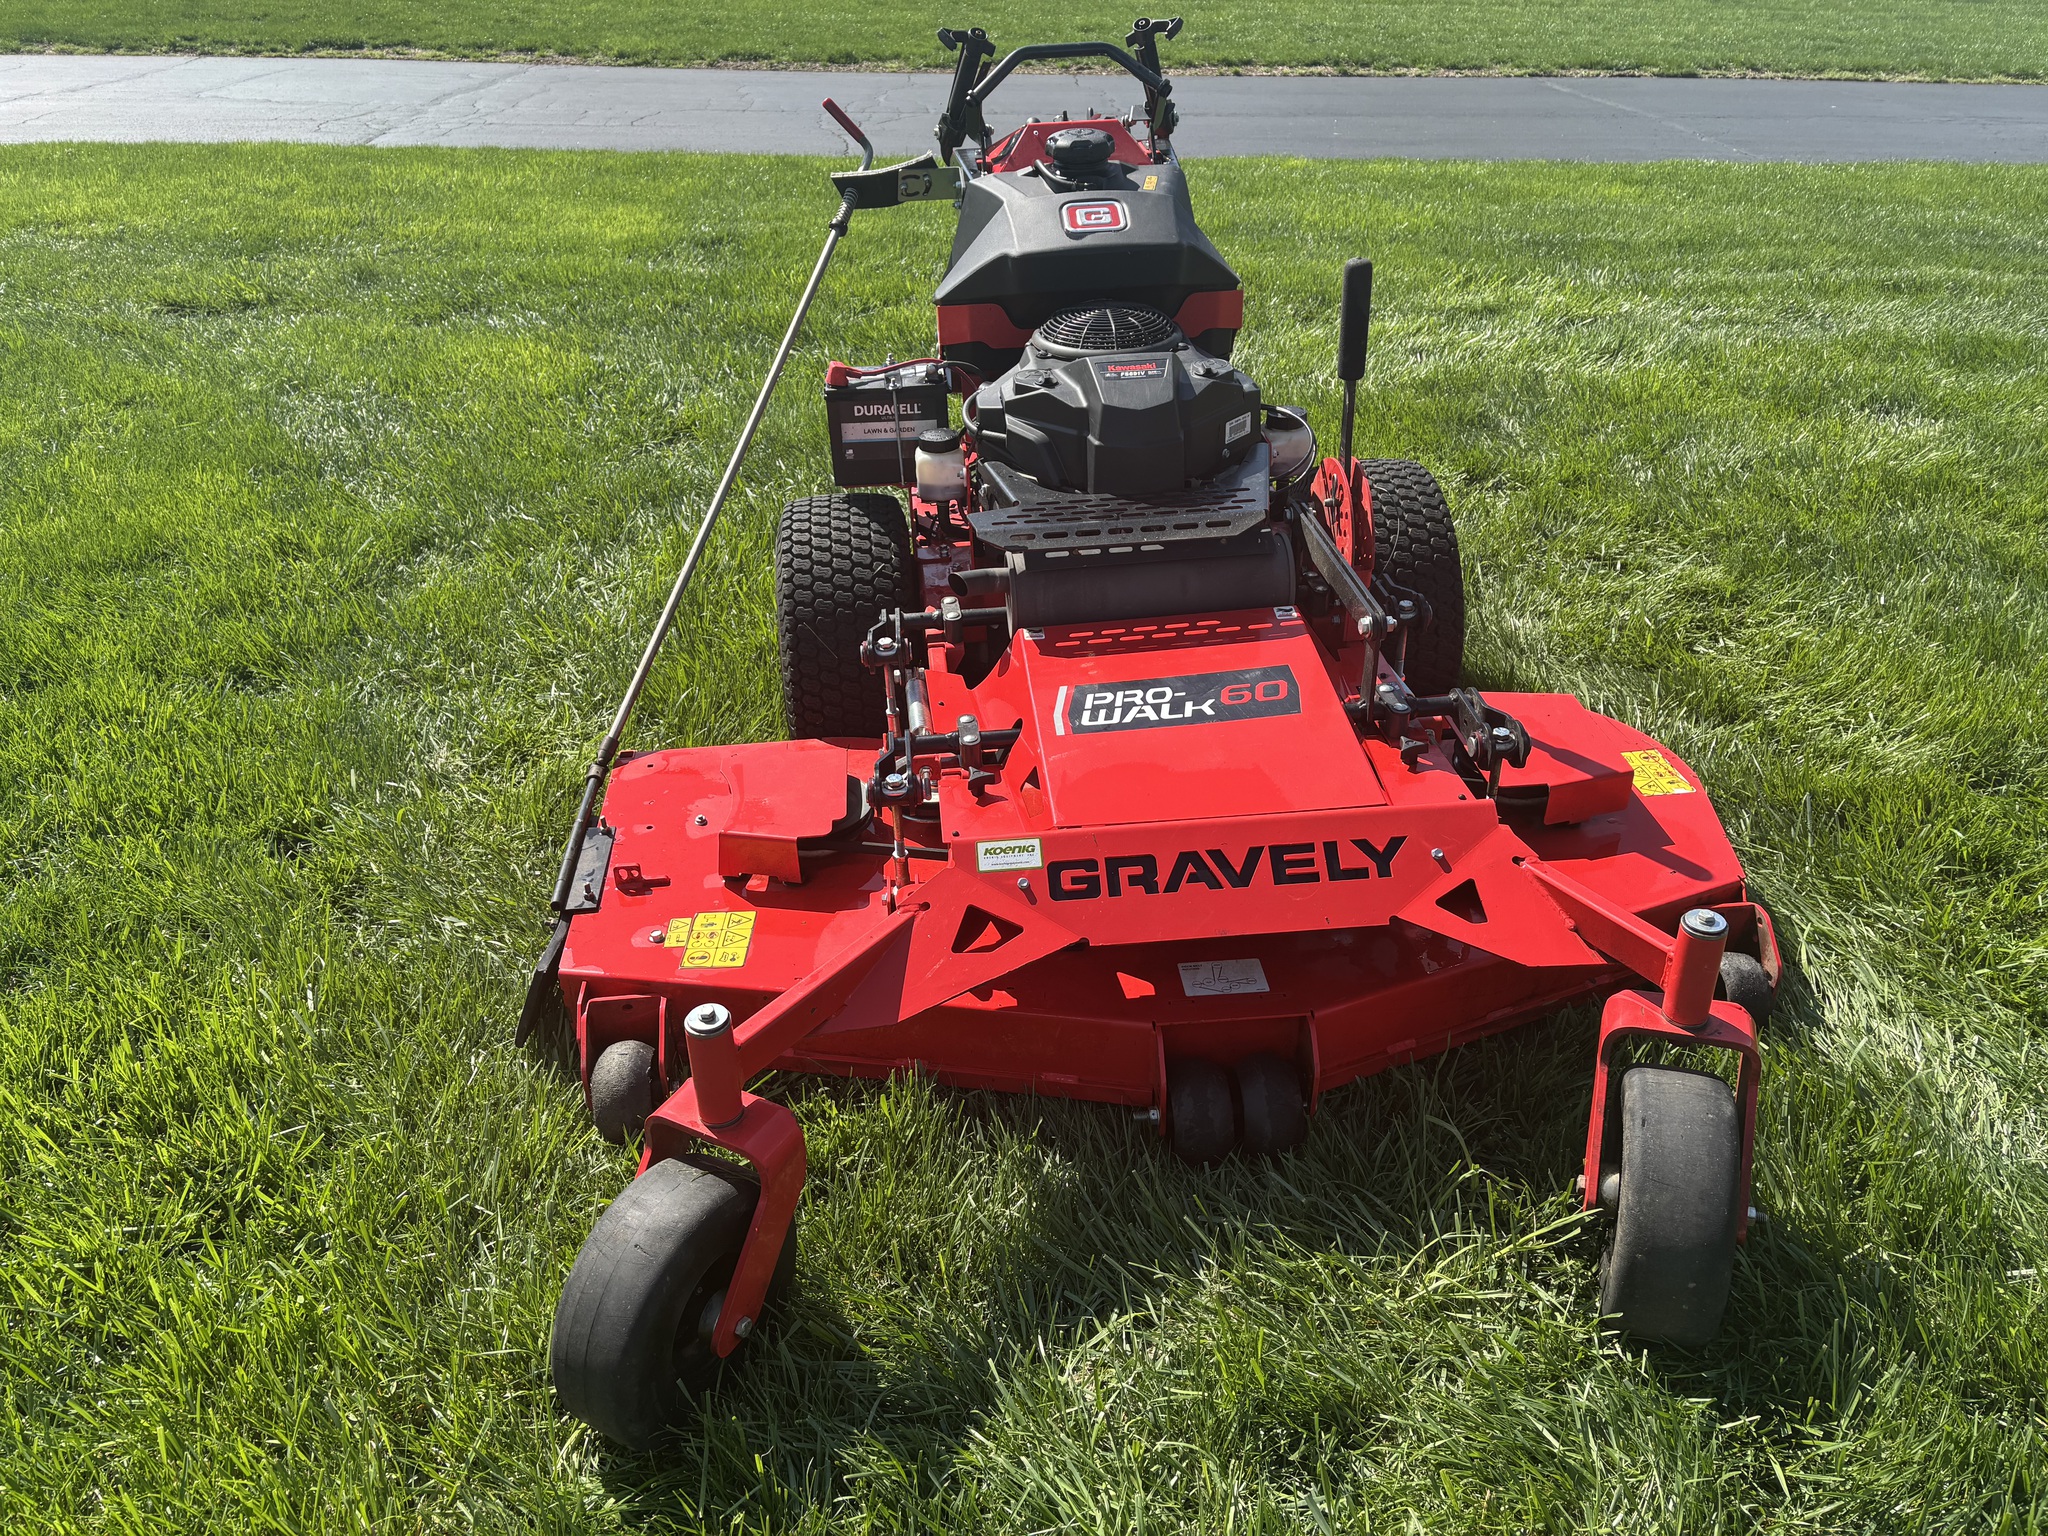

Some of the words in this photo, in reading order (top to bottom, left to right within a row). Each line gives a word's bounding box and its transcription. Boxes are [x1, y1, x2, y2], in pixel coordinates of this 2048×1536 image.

[1076, 207, 1112, 226] G
[1107, 363, 1157, 371] Kawasaki
[854, 403, 921, 416] DURACELL
[863, 427, 882, 435] LAWN
[1084, 686, 1187, 710] PRO-
[1220, 679, 1288, 706] 60
[1080, 698, 1216, 726] WALK
[1046, 835, 1409, 902] GRAVELY
